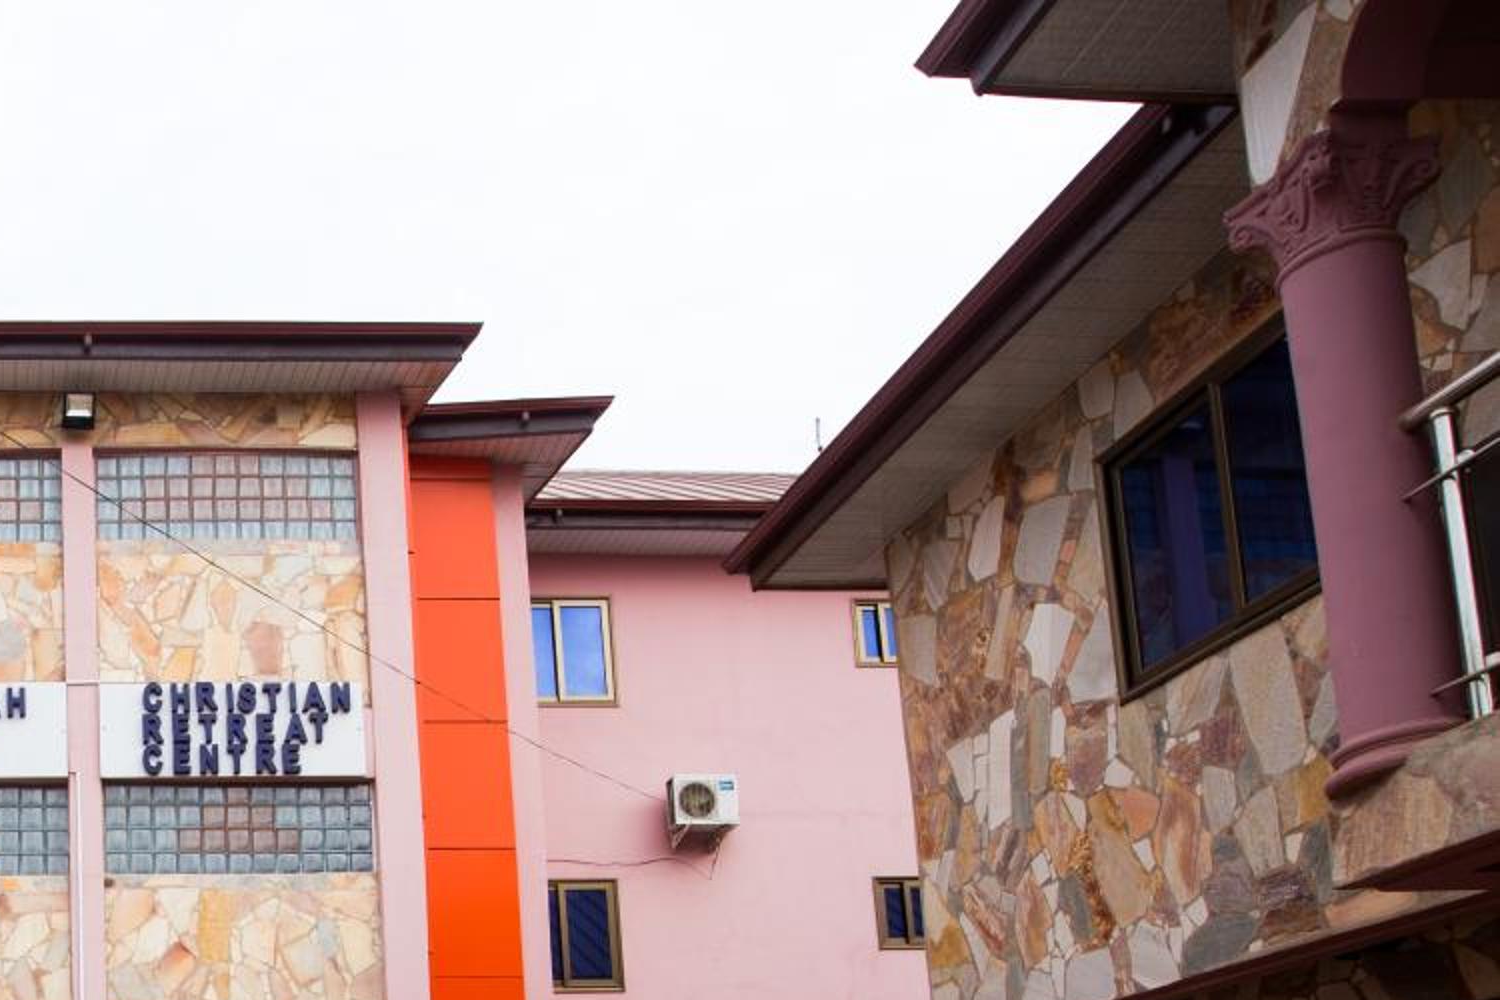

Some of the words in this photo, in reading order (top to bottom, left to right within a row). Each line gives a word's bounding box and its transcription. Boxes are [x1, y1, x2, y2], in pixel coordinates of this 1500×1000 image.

[142, 681, 350, 714] CHRISTIAN
[142, 712, 329, 745] RETREAT
[142, 744, 302, 776] CENTRE
